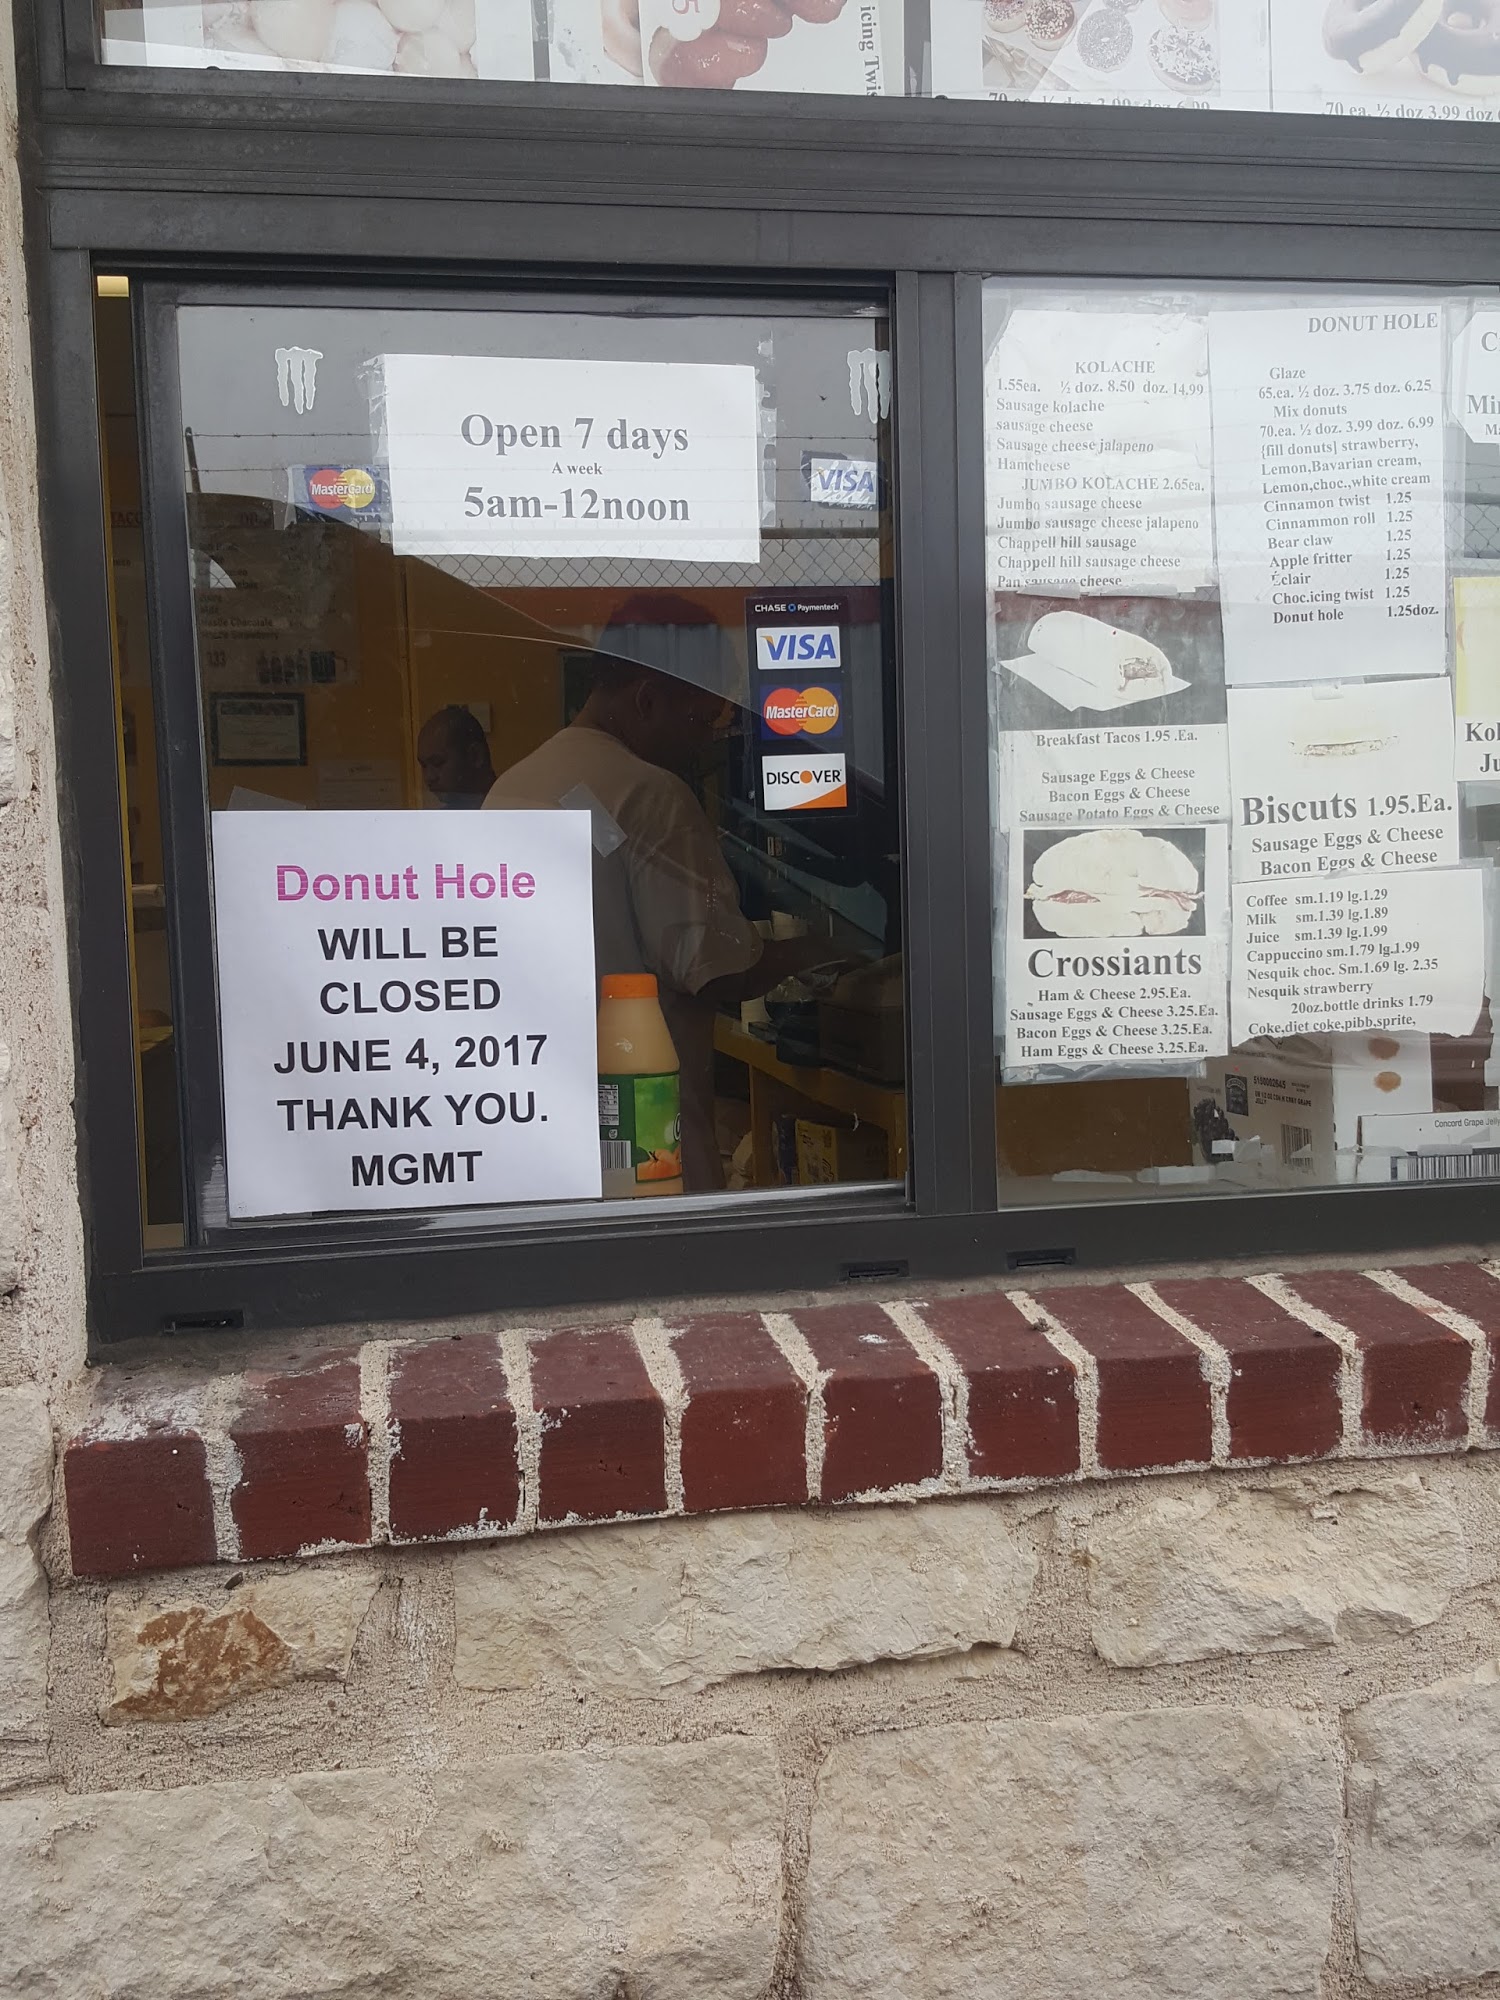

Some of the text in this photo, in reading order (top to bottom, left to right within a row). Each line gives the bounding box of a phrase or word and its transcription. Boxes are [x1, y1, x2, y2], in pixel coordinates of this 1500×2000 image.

[858, 6, 876, 51] icing
[1308, 312, 1438, 333] DONUT HOLE
[1075, 360, 1156, 374] KOLACHE
[1270, 367, 1306, 380] Glaze
[997, 378, 1204, 396] 1.55ea. doz. 8.50 doz. 14.99
[1314, 379, 1432, 398] doz. 3.75 doz. 6.25
[997, 398, 1104, 415] Sausage kolache
[1274, 404, 1347, 418] Mix donuts
[996, 420, 1093, 434] sausage cheese
[1315, 416, 1434, 435] doz. 3.99 doz. 6.99
[461, 414, 688, 459] Open 7 days
[1342, 437, 1418, 452] strawberry,
[997, 438, 1096, 455] Sausage cheese
[552, 462, 602, 474] A week
[1377, 456, 1422, 468] cream,
[817, 467, 874, 492] VISA
[1022, 476, 1204, 492] JUMBO KOLACHE 2.65ea.
[1391, 473, 1430, 486] cream
[311, 483, 372, 496] MasterCard
[464, 487, 690, 521] 5am-12noon
[997, 497, 1142, 512] Jumbo sausage cheese
[1264, 492, 1412, 513] Cinnamon twist 1.25
[997, 517, 1199, 532] Jumbo sausage cheese jalapeno
[1354, 512, 1376, 526] roll
[1387, 510, 1413, 523] 1.25
[997, 536, 1137, 552] Chappell hill sausage
[1268, 529, 1412, 550] Bear claw 1.25
[997, 556, 1181, 572] Chappell hill sausage cheese
[1270, 548, 1411, 570] Apple fritter 1.25
[997, 575, 1020, 588] Pan
[1080, 575, 1122, 587] cheese
[1385, 567, 1410, 580] 1.25
[1272, 586, 1410, 605] Choc.icing twist 1.25
[755, 604, 839, 612] CHASE Paymentech
[1274, 605, 1440, 624] Donut hole 1.25doz.
[760, 634, 836, 660] VISA
[766, 704, 837, 720] MasterCard
[1036, 732, 1140, 746] Breakfast Tacos
[766, 770, 841, 785] DISCOVER
[1042, 768, 1195, 785] Sausage Eggs Cheese
[1050, 786, 1190, 803] Bacon Eggs Cheese
[1019, 804, 1220, 824] Sausage Potato Cheese
[1240, 793, 1452, 826] Biscuts 1.95.Ea.
[1252, 827, 1444, 854] Sausage Eggs & Cheese
[1261, 850, 1438, 876] Bacon & Cheese
[276, 863, 536, 901] Donut Hole
[1246, 888, 1388, 908] Coffee sm.1.19 lg.1.29
[1246, 906, 1388, 926] Milk sm.1.39 lg.1.89
[318, 926, 498, 960] WILL BE
[1246, 925, 1388, 944] Juice sm.1.39 lg.1.99
[1028, 947, 1202, 978] Crossiants
[1247, 944, 1374, 964] Cappuccino sm.1.79
[1247, 958, 1438, 982] Nesquik choc. Sm.1.69 2.35
[320, 978, 500, 1014] CLOSED
[1038, 986, 1191, 1002] Ham Cheese 2.95.Ea.
[1248, 980, 1374, 1000] Nesquik strawberry
[1010, 1004, 1218, 1022] Sausage Eggs Cheese 3.25.Ea.
[1292, 994, 1434, 1014] 20oz.bottle drinks 1.79
[1016, 1023, 1212, 1040] Bacon Eggs Cheese 3.25.Ea.
[274, 1034, 548, 1076] JUNE 4, 2017
[1021, 1041, 1208, 1059] Ham Eggs Cheese 3.25.Ea.
[277, 1092, 548, 1131] THANK YOU.
[1434, 1118, 1484, 1128] Concord Grape
[352, 1151, 482, 1187] MGMT
